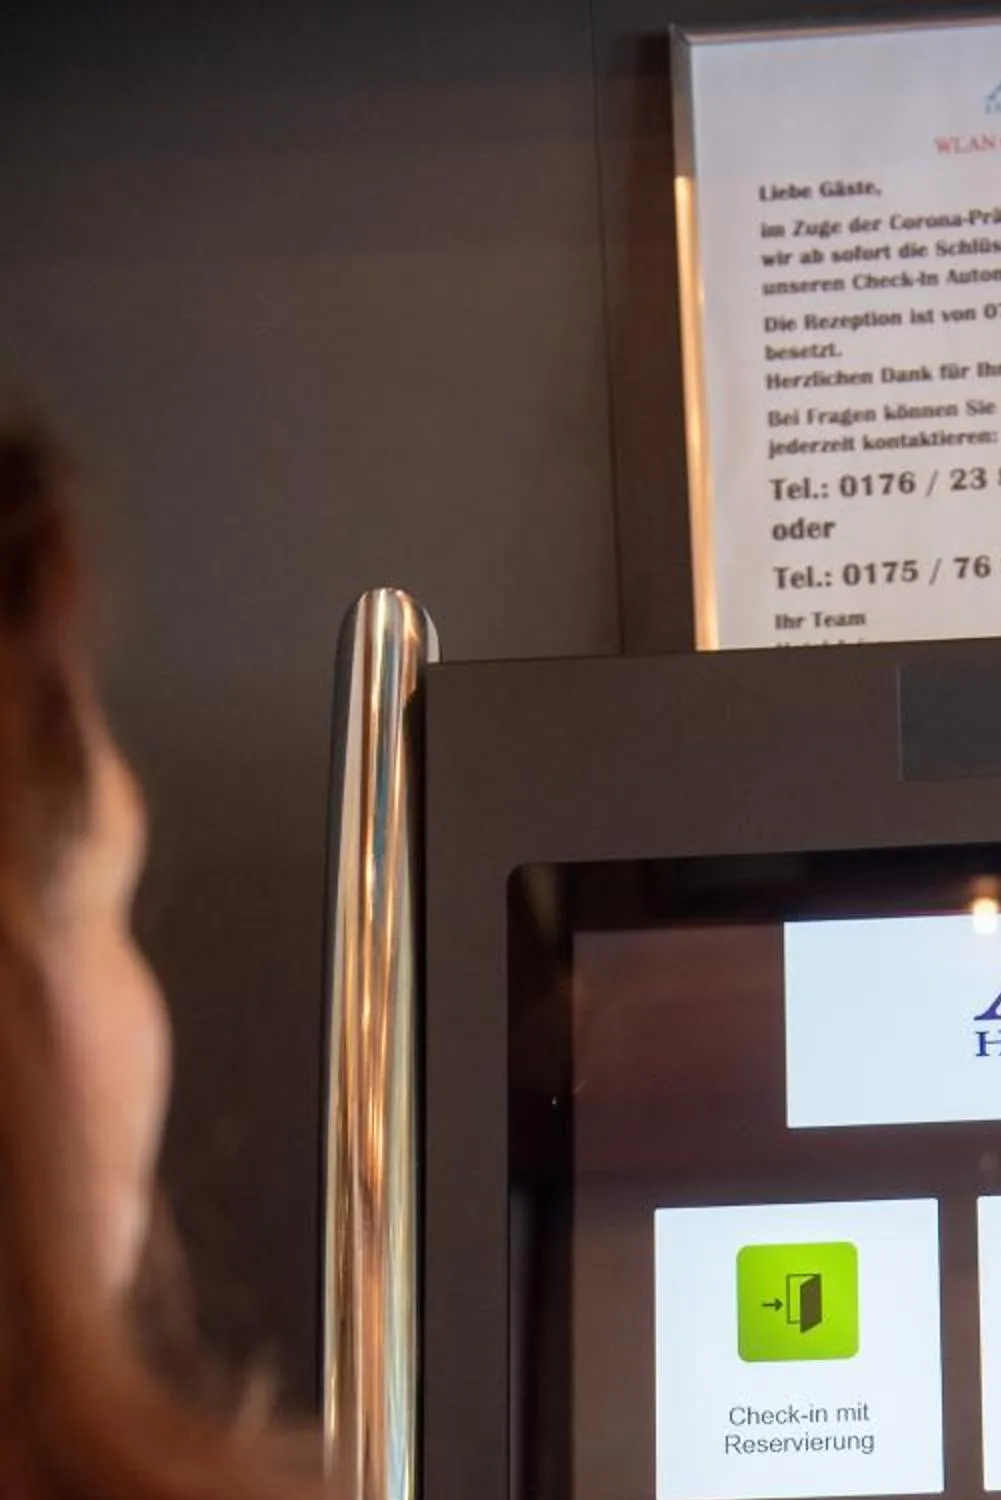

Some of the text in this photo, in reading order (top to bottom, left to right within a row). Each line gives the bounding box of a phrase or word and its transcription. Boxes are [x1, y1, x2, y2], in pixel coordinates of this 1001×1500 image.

[934, 132, 997, 154] WLAN
[759, 180, 883, 201] Liebe Gäste,
[760, 222, 786, 238] im
[792, 219, 842, 239] Zuge
[849, 216, 882, 233] der
[761, 250, 793, 267] wir
[800, 247, 825, 264] ab
[831, 245, 892, 263] sofort
[898, 241, 929, 259] die
[762, 277, 845, 296] unseren
[764, 315, 798, 333] Die
[804, 311, 903, 333] Rezeption
[910, 306, 935, 325] ist
[942, 308, 977, 324] von
[765, 342, 843, 361] besetzt.
[766, 370, 874, 390] Herzlichen
[881, 366, 932, 384] Dank
[940, 362, 971, 379] für
[768, 409, 800, 427] Bei
[806, 407, 877, 427] Fragen
[884, 403, 959, 421] können
[965, 399, 997, 416] Sie
[768, 430, 999, 460] jederzeit kontaktieren:
[769, 476, 829, 501] Tel.:
[839, 471, 917, 498] 0176
[926, 470, 939, 498] /
[950, 466, 988, 491] 23
[771, 517, 837, 541] oder
[773, 565, 832, 590] Tel.:
[842, 559, 920, 586] 0175
[929, 558, 943, 586] /
[953, 554, 992, 579] 76
[774, 611, 866, 630] Ihr Team
[728, 1400, 871, 1426] Check-in mit
[724, 1431, 875, 1456] Reservierung
